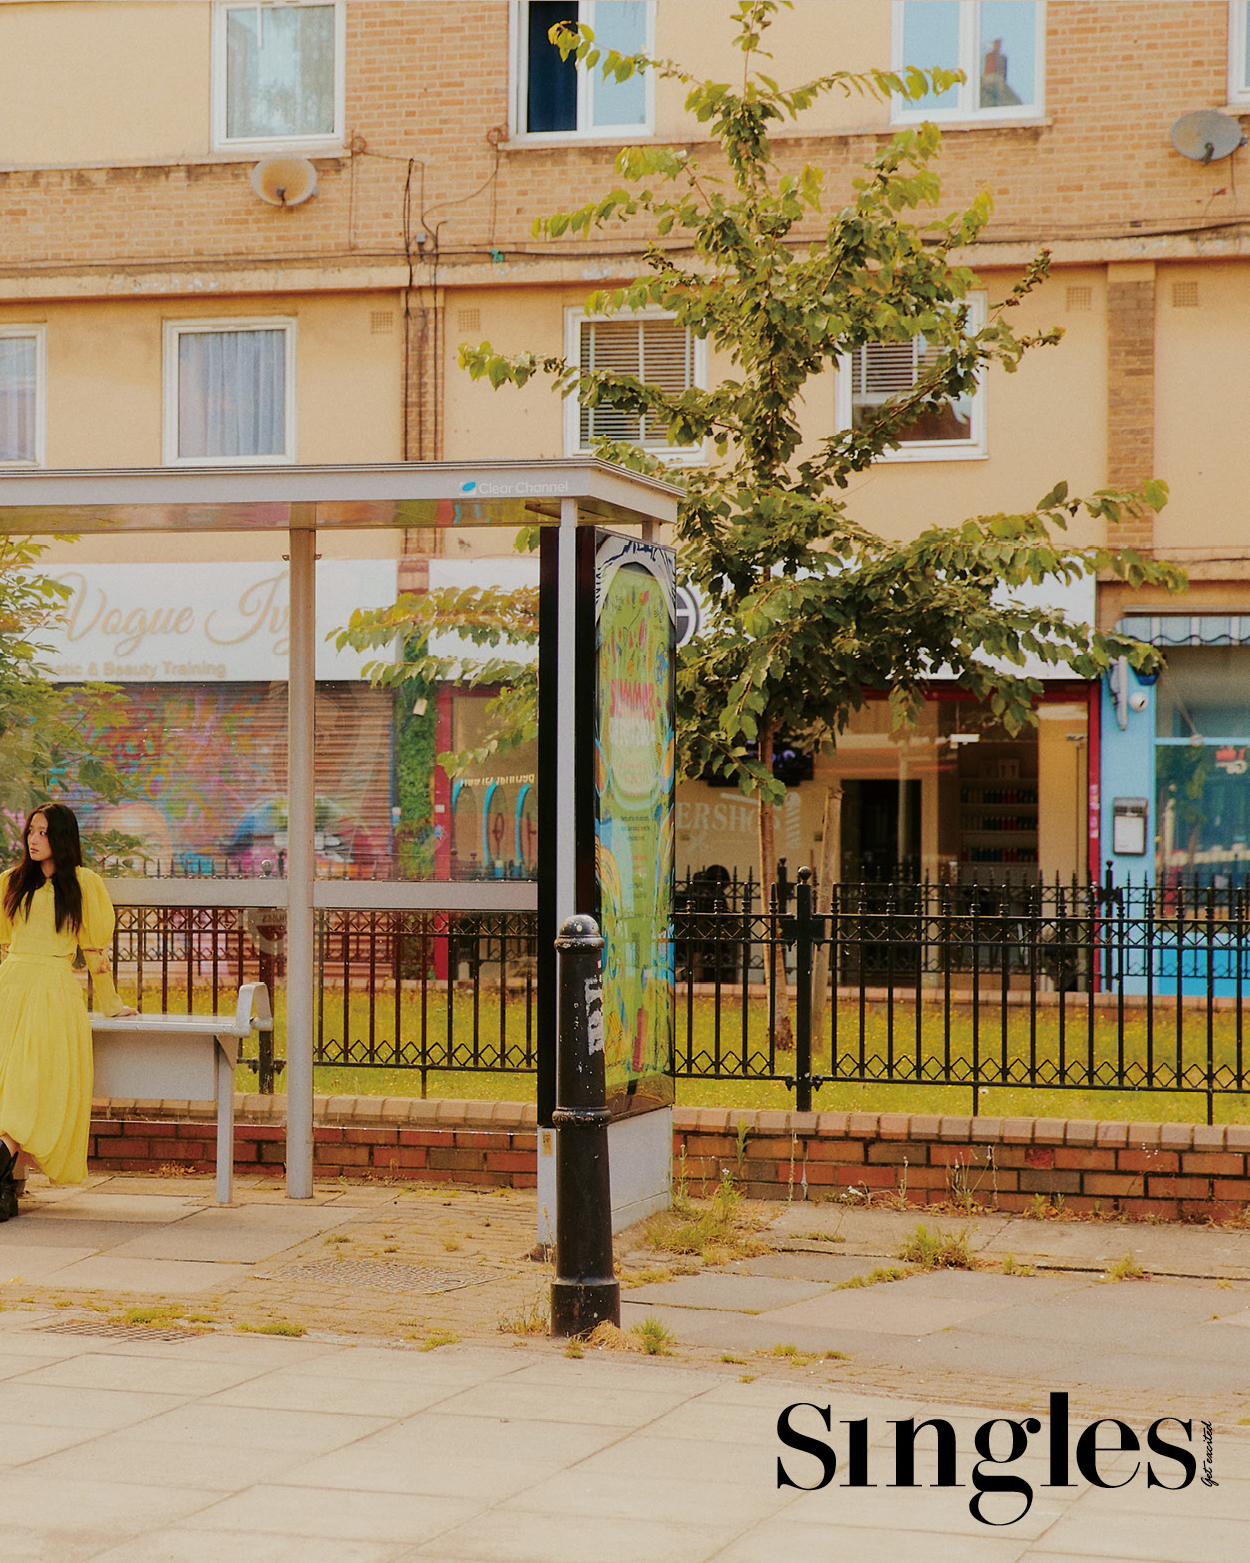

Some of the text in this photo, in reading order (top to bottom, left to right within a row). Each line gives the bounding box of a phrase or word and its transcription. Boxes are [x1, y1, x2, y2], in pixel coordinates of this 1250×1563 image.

[478, 480, 568, 495] Clear Channel
[51, 571, 196, 657] Vogue
[104, 662, 156, 679] Beauty
[163, 660, 226, 679] Training
